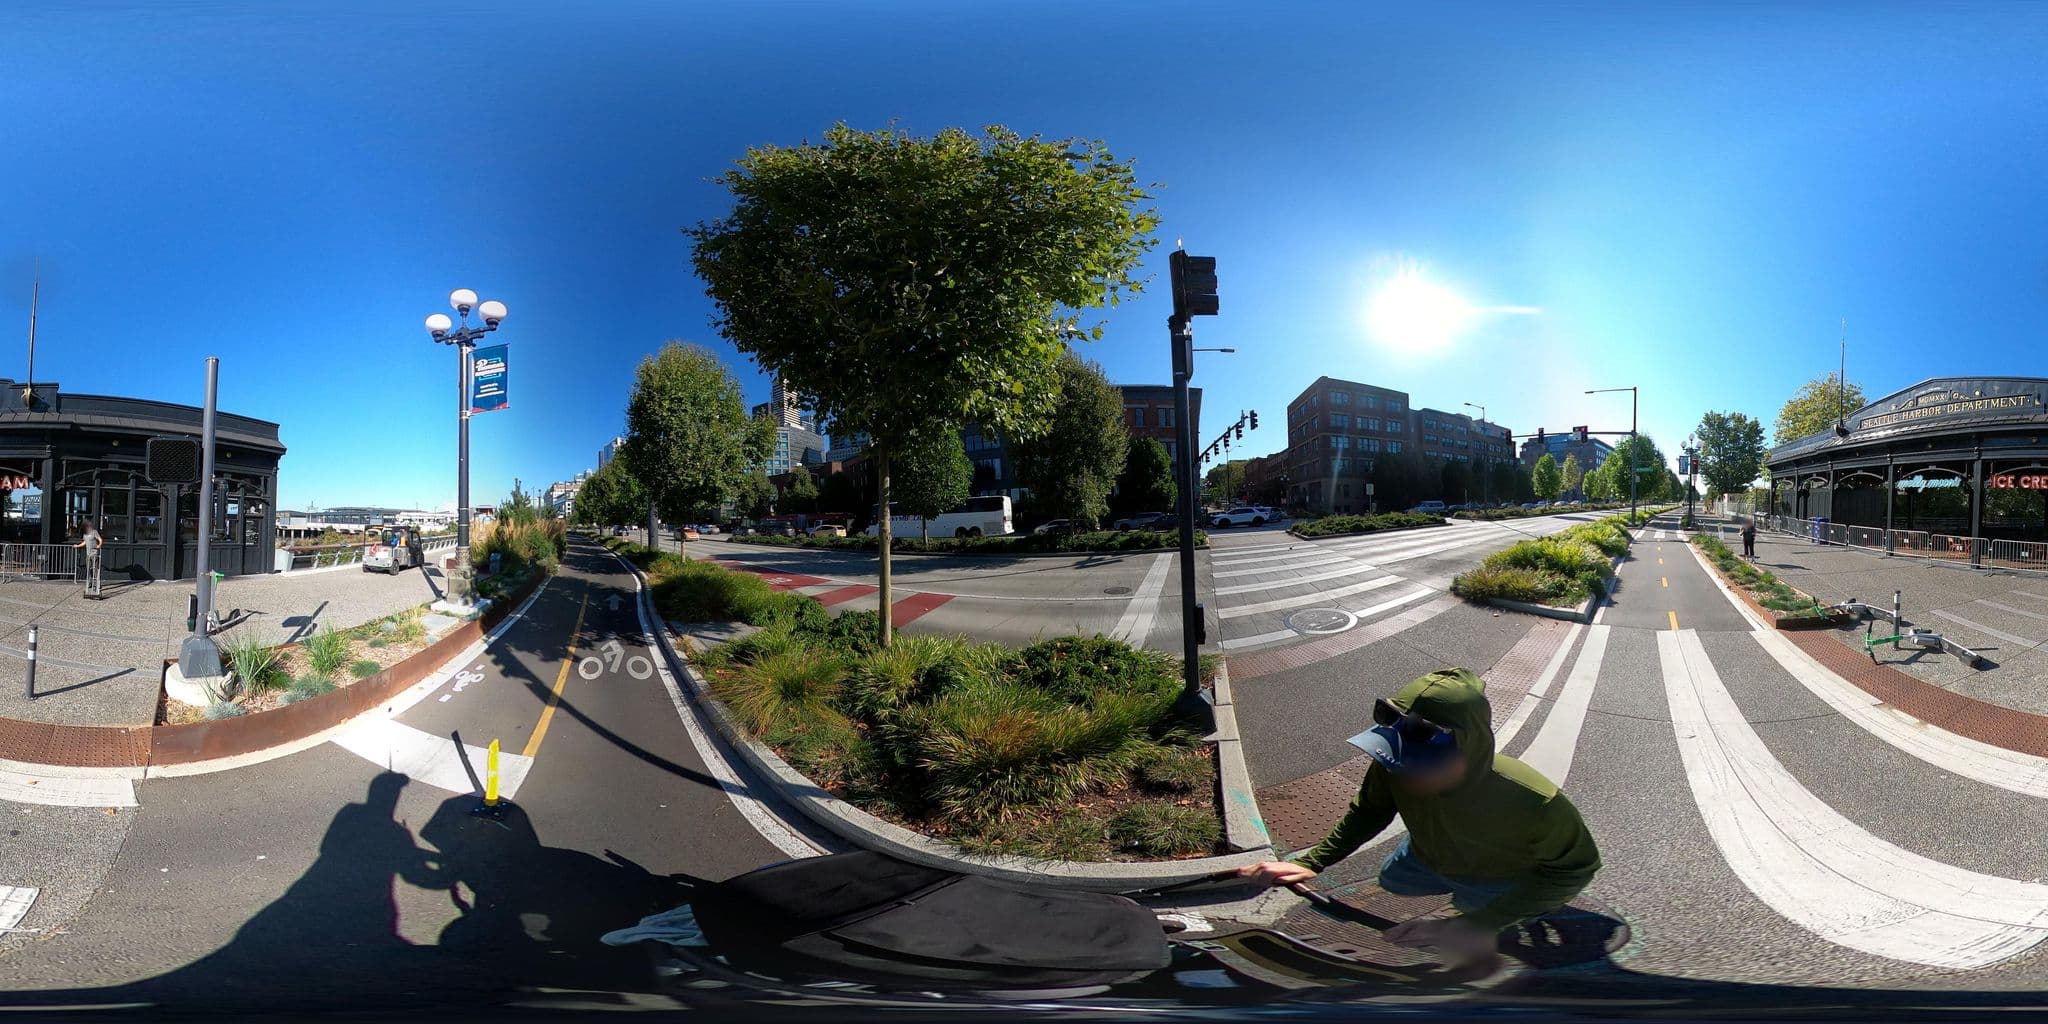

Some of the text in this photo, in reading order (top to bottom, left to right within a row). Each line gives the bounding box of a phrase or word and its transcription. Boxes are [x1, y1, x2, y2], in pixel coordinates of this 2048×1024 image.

[1863, 396, 2026, 428] SEATTLE HARBOR DEPARTMENT
[1991, 474, 2048, 489] ICE CRE
